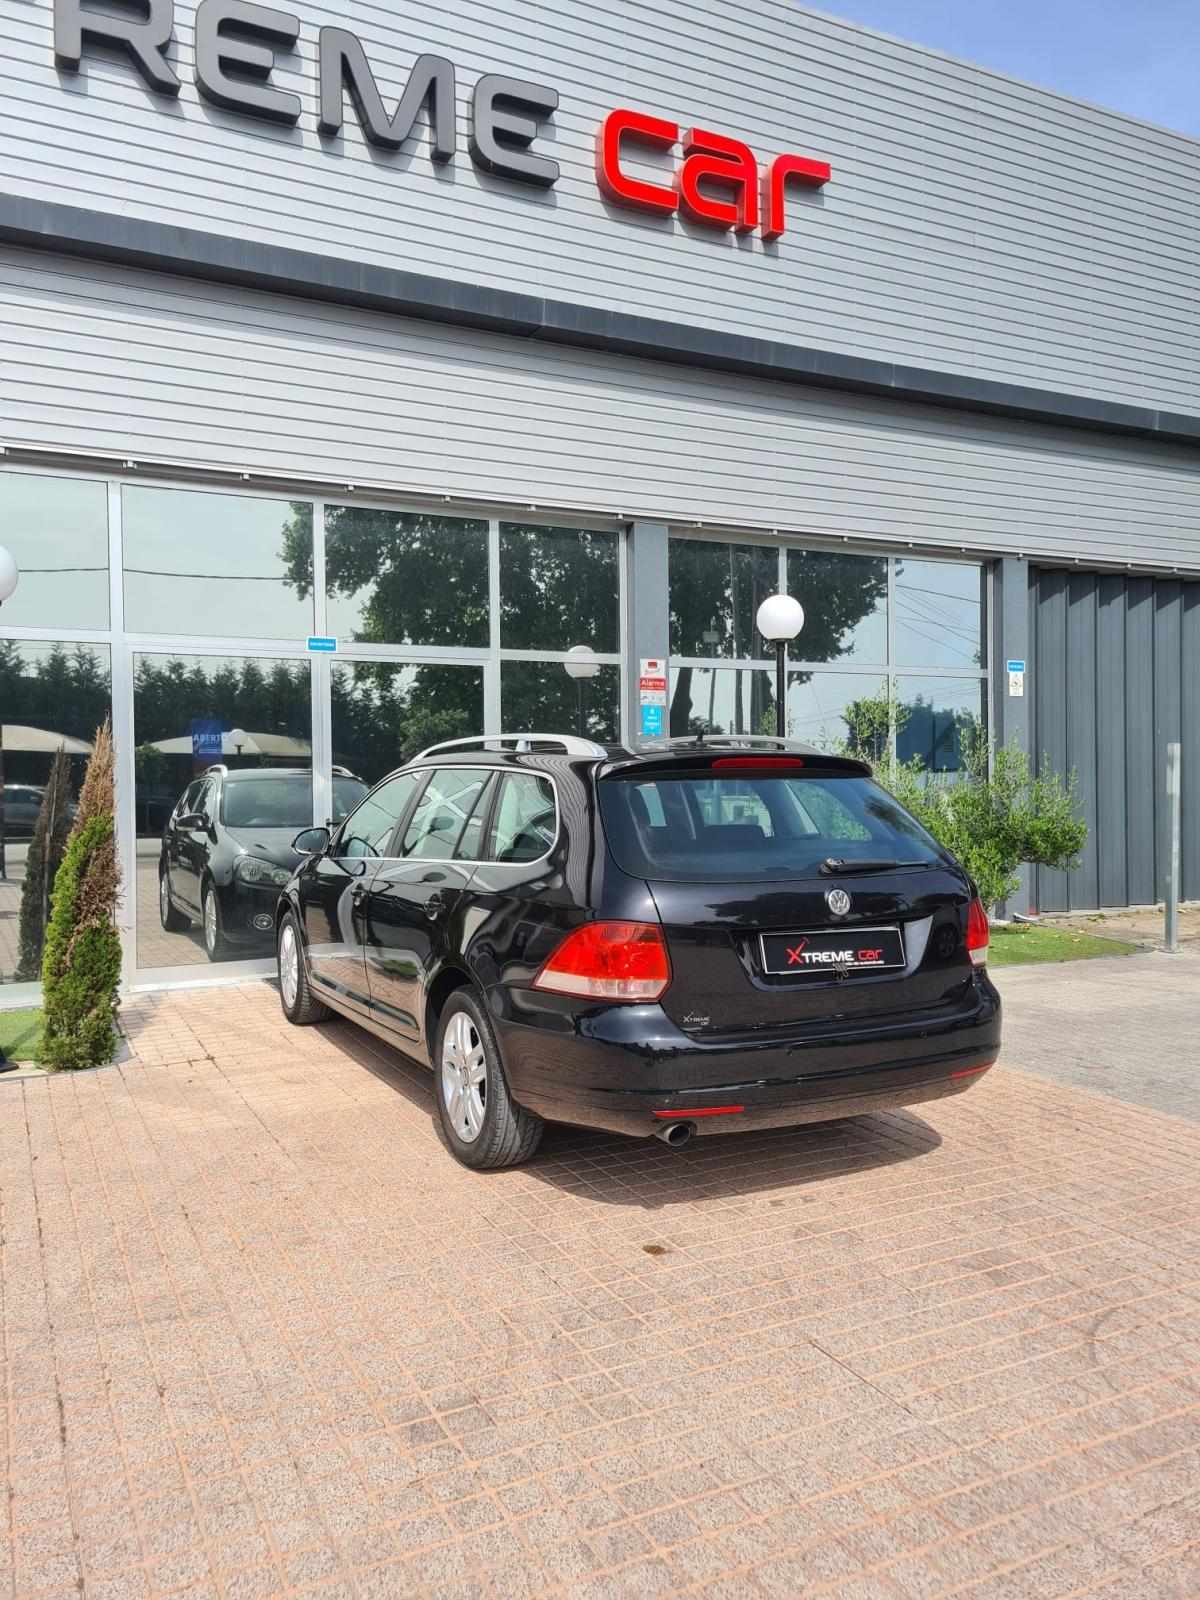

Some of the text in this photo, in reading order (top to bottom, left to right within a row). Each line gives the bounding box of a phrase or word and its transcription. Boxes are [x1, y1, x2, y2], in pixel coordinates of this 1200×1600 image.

[597, 108, 831, 242] car
[787, 937, 883, 964] XTREME car
